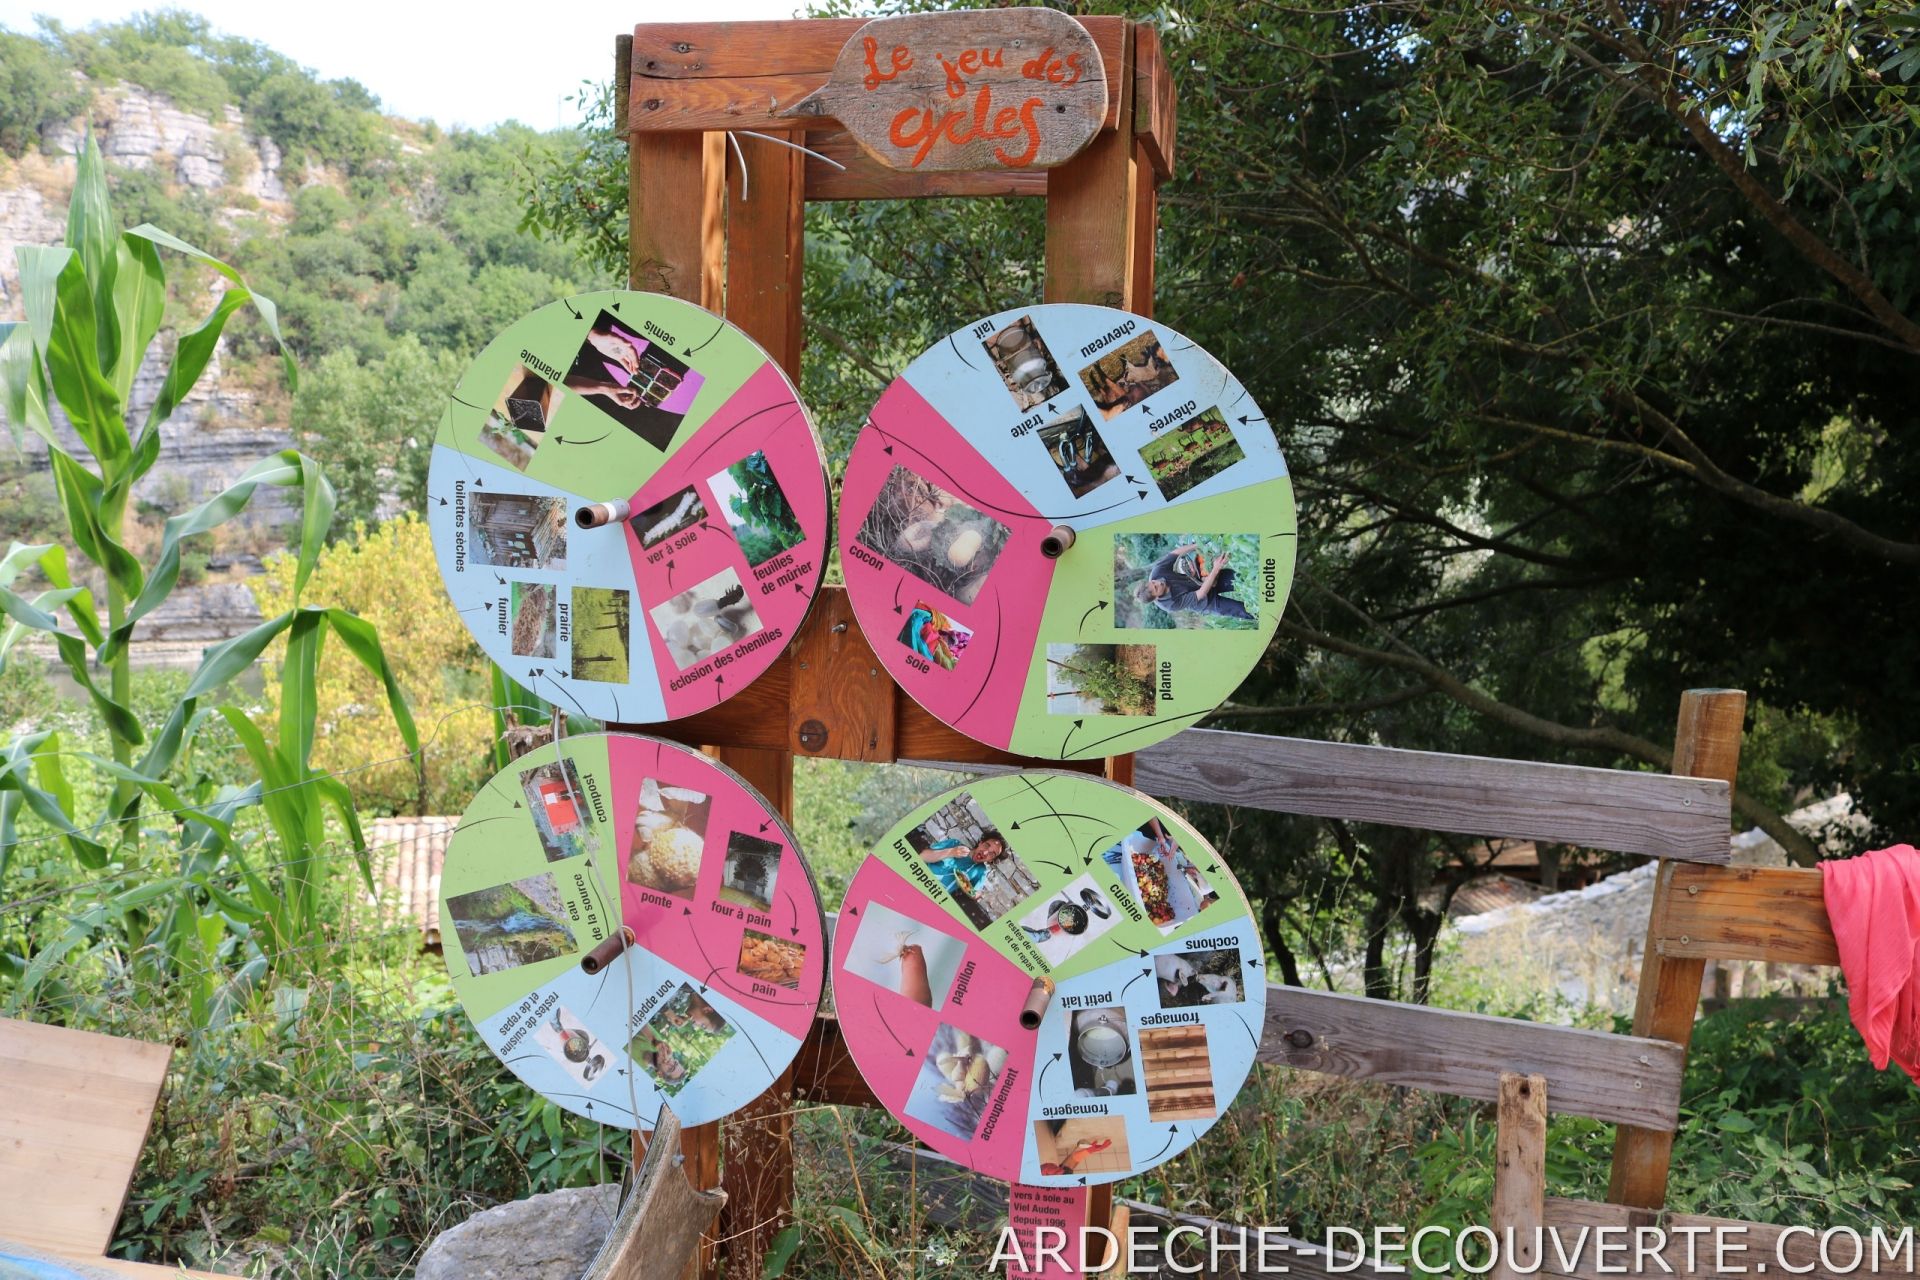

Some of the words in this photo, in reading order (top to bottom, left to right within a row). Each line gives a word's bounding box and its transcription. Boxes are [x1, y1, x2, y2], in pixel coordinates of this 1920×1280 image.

[863, 36, 913, 91] Le
[936, 47, 1004, 98] jeu
[1021, 47, 1083, 88] des
[643, 319, 676, 346] semis
[972, 320, 996, 340] lait
[1080, 319, 1136, 358] chevreau
[520, 349, 563, 382] plantule
[1010, 413, 1044, 439] traite
[1149, 400, 1197, 432] chèvres
[456, 480, 466, 528] toilettes
[456, 531, 466, 573] sèches
[646, 551, 664, 565] ver
[665, 543, 674, 555] à
[675, 531, 698, 550] soie
[849, 545, 884, 571] cocon
[753, 553, 794, 581] feuilles
[761, 581, 777, 595] de
[776, 560, 813, 588] mûrier
[1261, 558, 1276, 603] récolte
[498, 597, 509, 636] fumier
[558, 603, 570, 642] prairie
[669, 664, 713, 692] éclosion
[714, 653, 734, 670] des
[734, 627, 783, 658] chenilles
[905, 654, 930, 674] soie
[1159, 661, 1174, 700] plante
[583, 774, 608, 823] compost
[893, 838, 912, 863] bon
[909, 862, 943, 900] appétit
[939, 896, 948, 905] !
[574, 873, 593, 911] source
[640, 892, 673, 909] ponte
[1109, 883, 1142, 922] cuisine
[567, 900, 580, 921] eau
[588, 912, 599, 925] la
[711, 901, 734, 917] four
[736, 908, 744, 919] à
[746, 911, 772, 928] pain
[592, 926, 603, 941] de
[1006, 919, 1024, 946] restes
[1023, 940, 1034, 952] de
[1030, 949, 1051, 974] cuisine
[1185, 936, 1239, 950] cochons
[1004, 935, 1013, 945] et
[1010, 941, 1021, 953] de
[1018, 951, 1035, 972] repas
[656, 979, 675, 998] bon
[752, 982, 777, 997] pain
[952, 960, 977, 1006] papillon
[519, 1001, 532, 1014] de
[529, 992, 540, 1005] et
[536, 991, 560, 1017] restes
[1061, 995, 1083, 1008] lait
[1084, 991, 1113, 1006] petit
[499, 1014, 522, 1036] repas
[525, 1016, 537, 1029] de
[1141, 1012, 1200, 1025] fromages
[500, 1028, 527, 1056] cuisine
[980, 1067, 1019, 1141] accouplement
[1042, 1104, 1109, 1118] fromagerie
[1013, 1192, 1033, 1200] vers
[1034, 1192, 1040, 1201] à
[1043, 1195, 1061, 1203] soie
[1063, 1196, 1075, 1204] au
[1013, 1202, 1030, 1212] Viel
[1032, 1204, 1060, 1215] Audon
[1013, 1215, 1042, 1226] depuis
